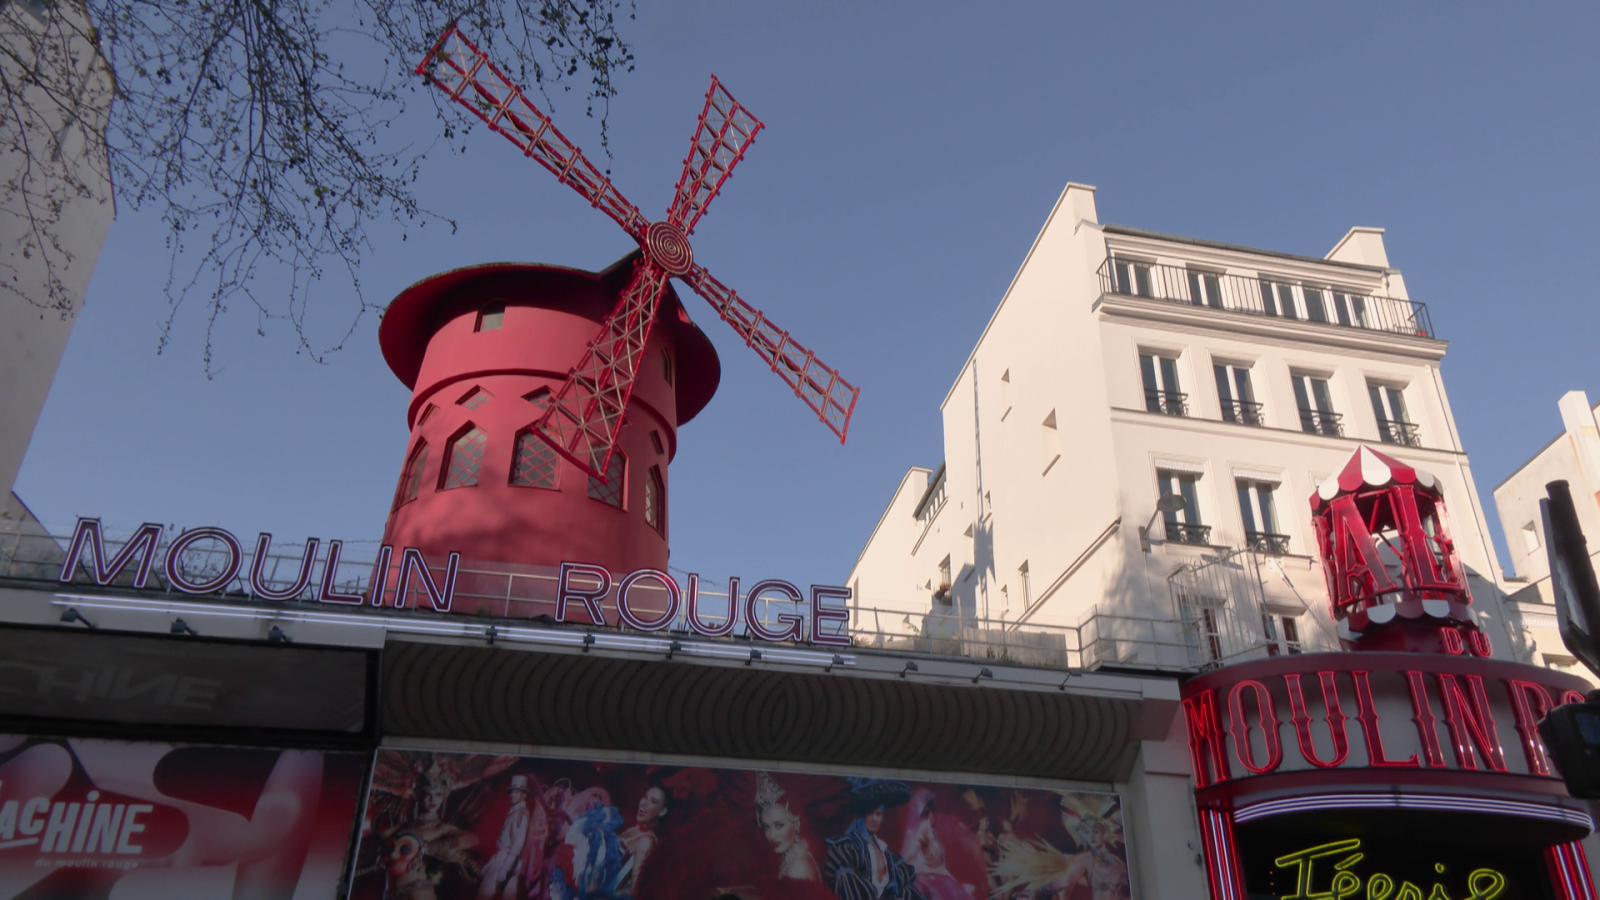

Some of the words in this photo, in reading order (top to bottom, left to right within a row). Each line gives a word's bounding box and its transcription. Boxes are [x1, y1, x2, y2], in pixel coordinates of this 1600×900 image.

[58, 516, 461, 612] MOULIN
[554, 560, 852, 646] ROUGE
[1441, 627, 1494, 658] DU
[1182, 670, 1508, 788] MOULIN
[35, 857, 51, 867] du
[55, 858, 98, 868] moulin
[102, 860, 138, 870] rouge
